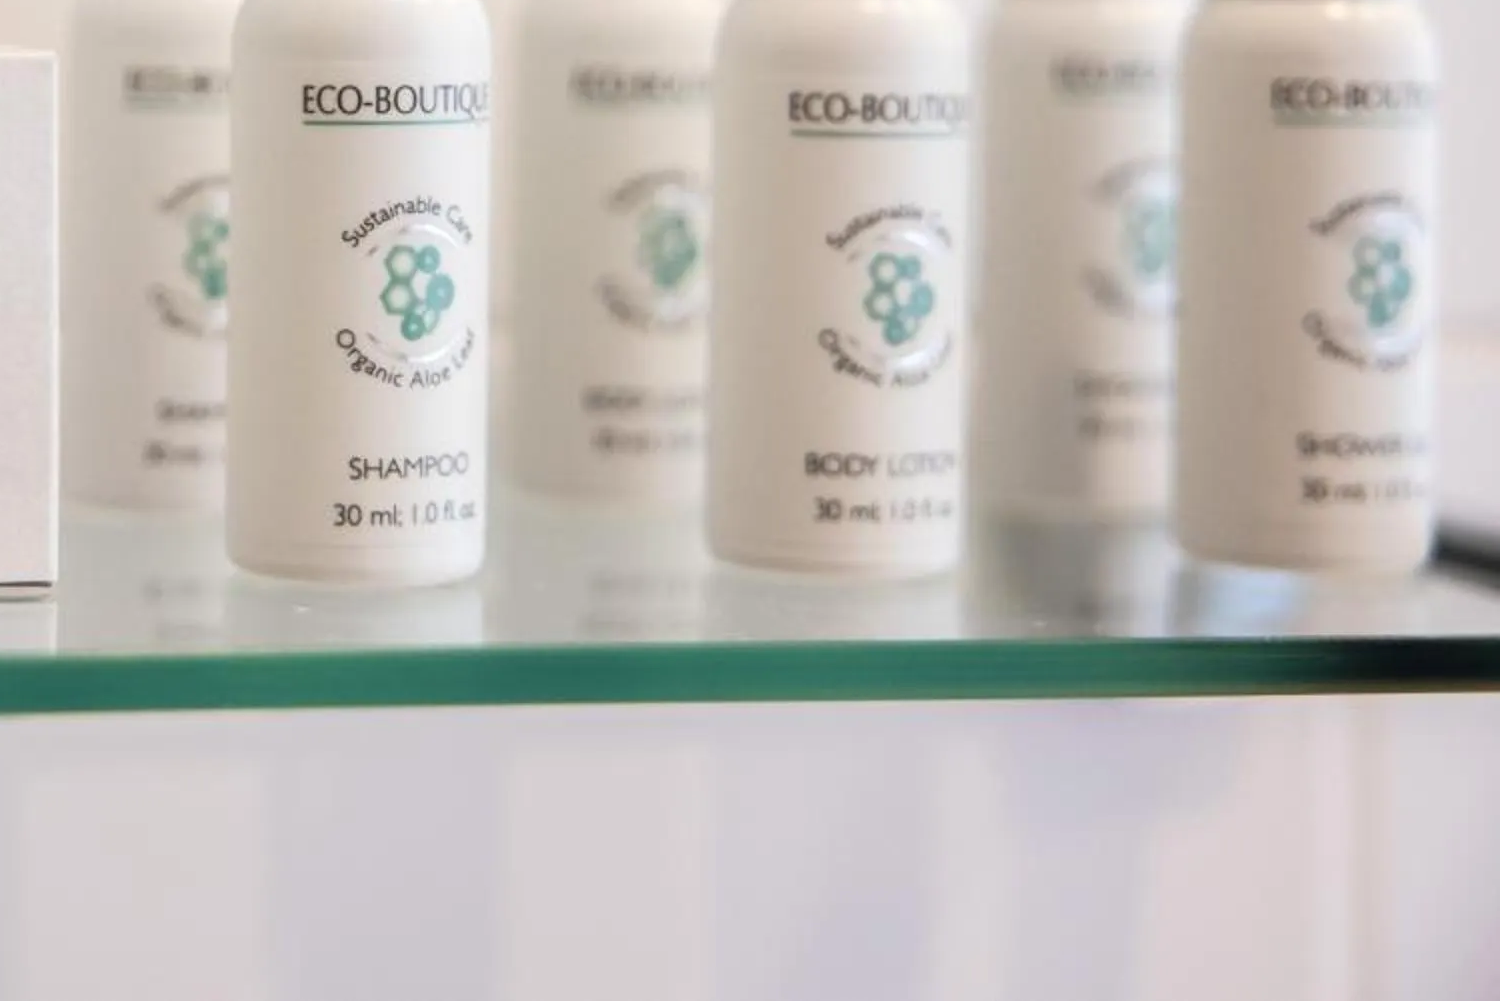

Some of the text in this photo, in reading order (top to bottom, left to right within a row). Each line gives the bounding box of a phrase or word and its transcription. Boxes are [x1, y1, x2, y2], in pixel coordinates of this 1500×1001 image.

[341, 196, 442, 248] Sustainable
[336, 328, 404, 388] Organic
[349, 451, 469, 480] SHAMPOO
[804, 452, 878, 479] BODY
[333, 503, 363, 527] 30
